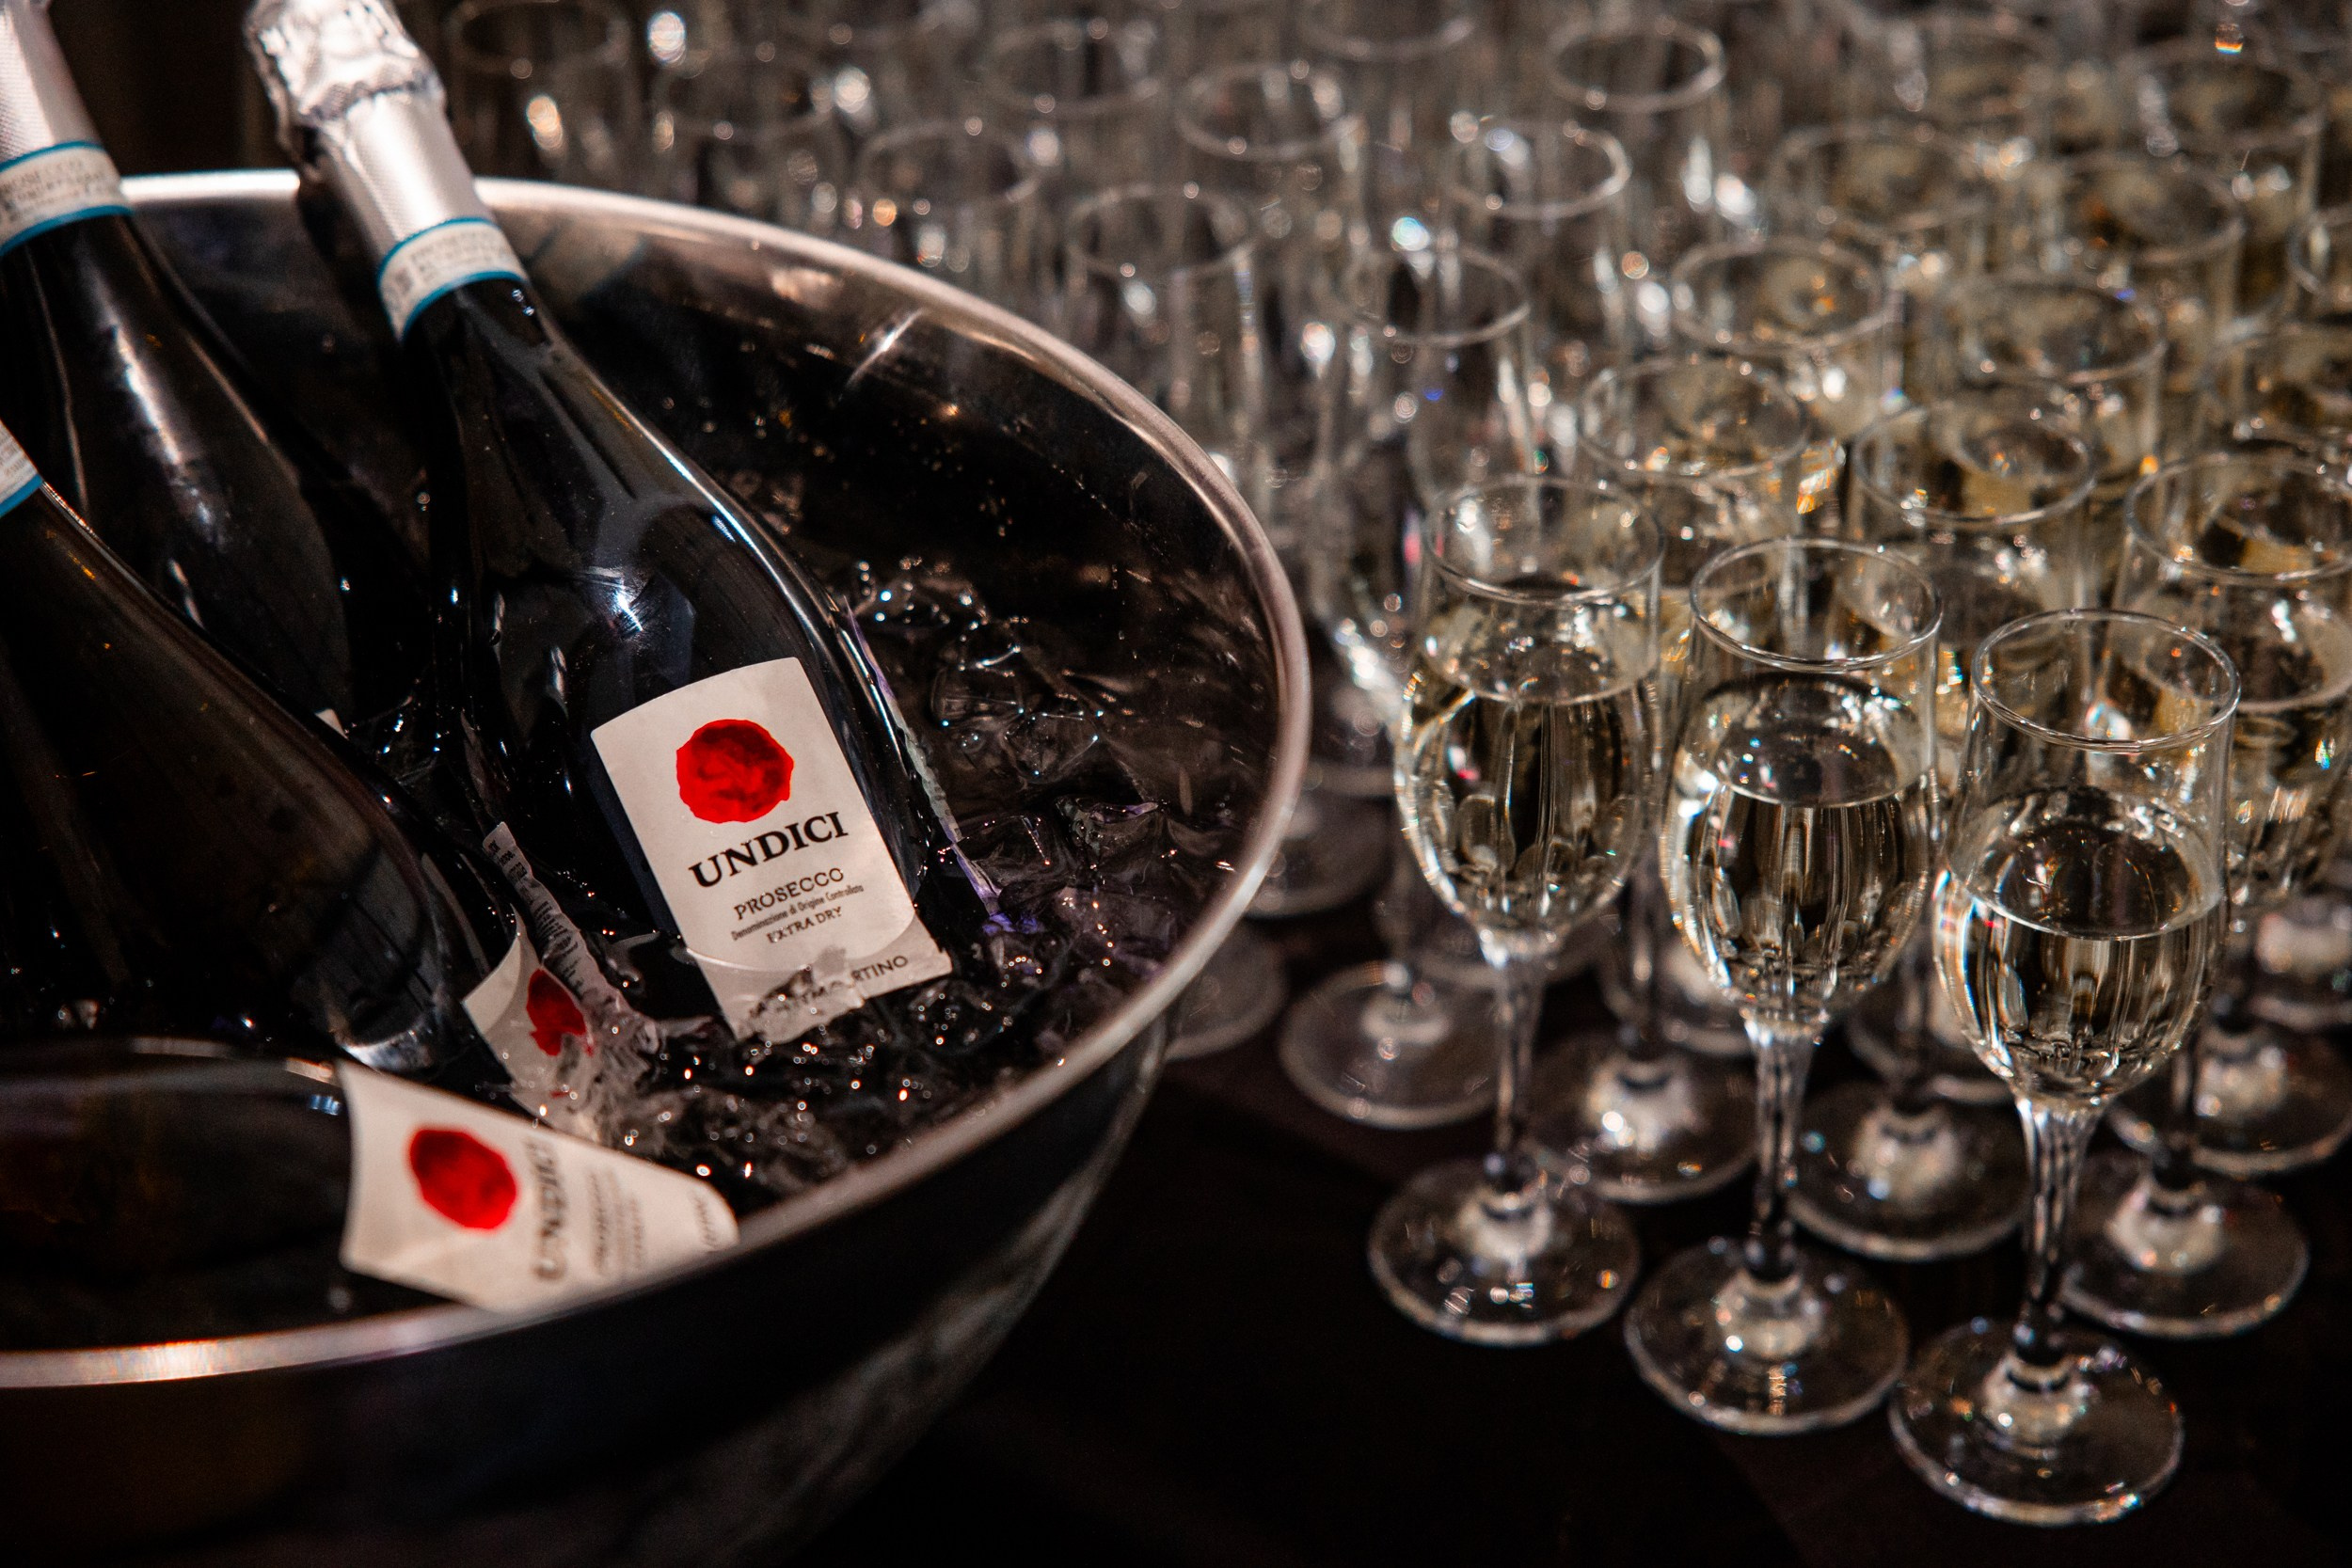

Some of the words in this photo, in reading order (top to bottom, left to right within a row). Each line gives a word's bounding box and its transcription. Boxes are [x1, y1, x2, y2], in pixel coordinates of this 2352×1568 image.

[688, 812, 849, 888] UNDICI
[734, 867, 844, 921] PROSECCO
[798, 896, 825, 911] Origine
[767, 917, 815, 943] EXTRA
[815, 906, 842, 924] DRY
